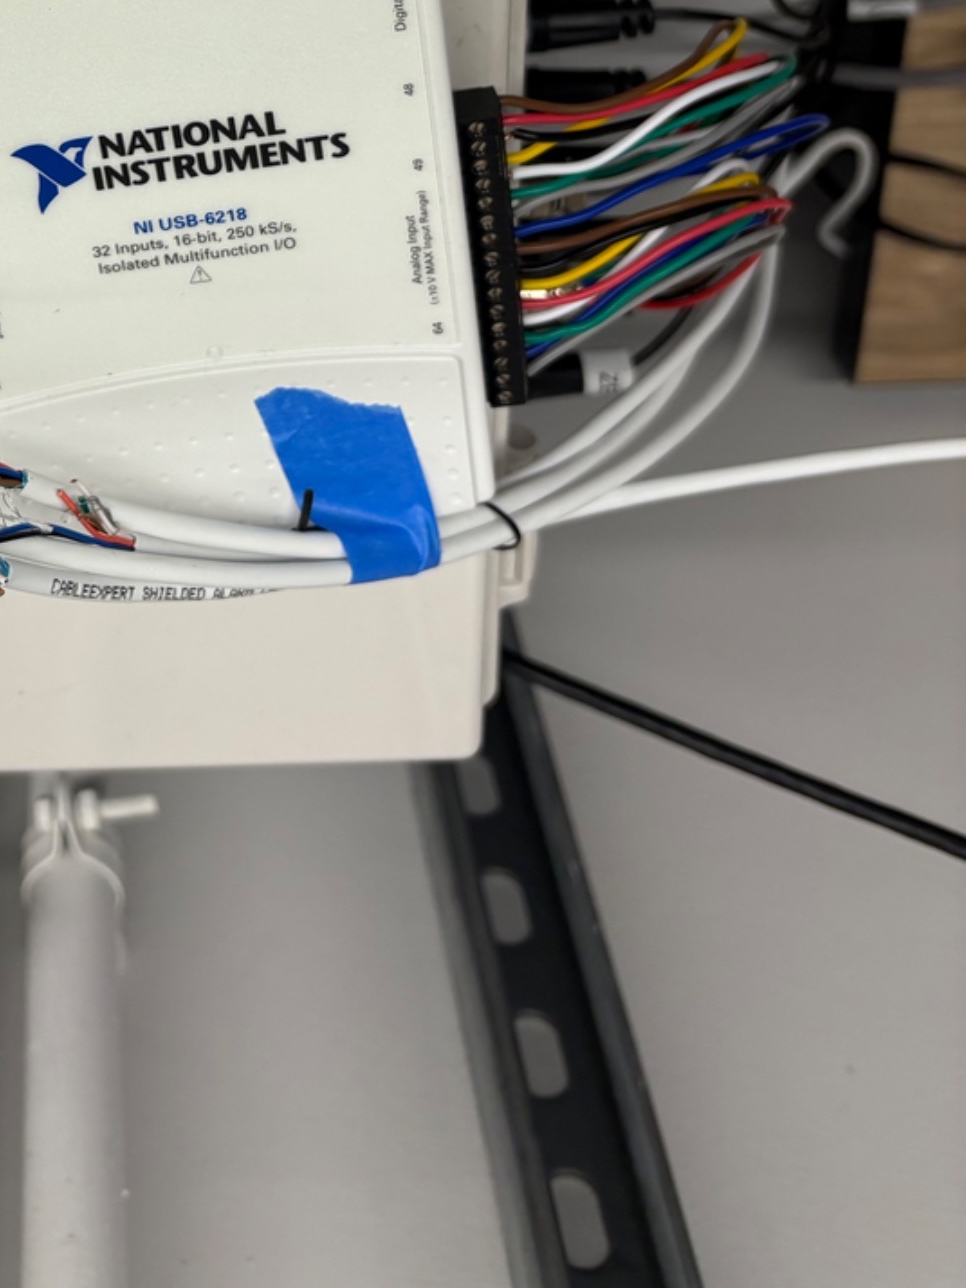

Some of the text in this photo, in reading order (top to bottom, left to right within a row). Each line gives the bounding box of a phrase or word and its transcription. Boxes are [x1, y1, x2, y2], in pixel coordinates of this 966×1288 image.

[403, 82, 414, 96] 48
[98, 111, 287, 159] NATIONAL
[92, 133, 351, 191] INSTRUMENTS
[412, 158, 424, 171] 49
[416, 190, 429, 223] Range)
[133, 207, 248, 234] NI USB-6218
[92, 245, 112, 258] 32
[115, 238, 169, 257] Inputs,
[173, 230, 222, 247] 16-bit,
[226, 226, 254, 240] 250
[405, 215, 423, 284] Analog Input
[422, 225, 433, 249] Input
[98, 237, 297, 274] Isolated Multifunction I/O
[425, 250, 436, 275] MAX
[432, 321, 444, 335] 64
[51, 578, 135, 601] CABLEEXPERT
[142, 586, 205, 601] SHIELDED
